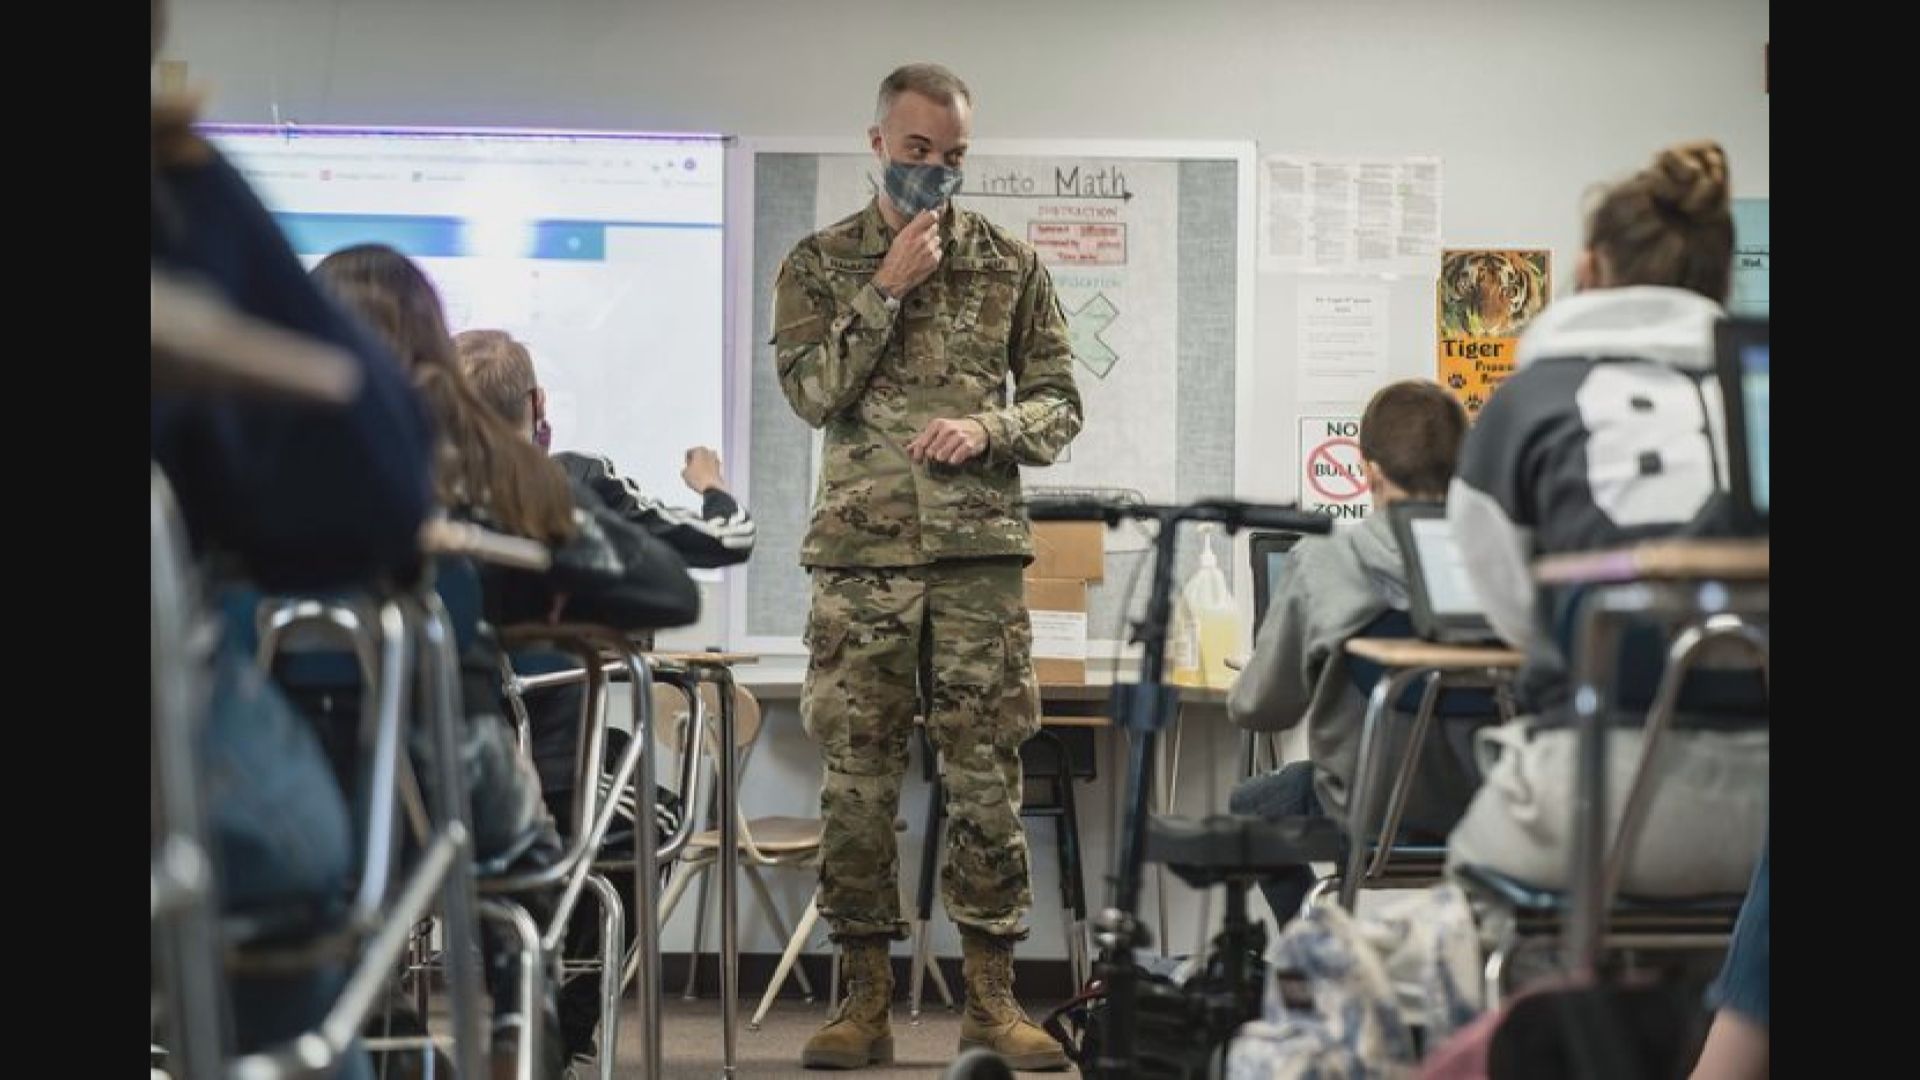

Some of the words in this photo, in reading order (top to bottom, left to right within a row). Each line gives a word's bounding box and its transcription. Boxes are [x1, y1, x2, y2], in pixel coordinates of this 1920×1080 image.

[981, 170, 1035, 194] into
[1055, 165, 1126, 198] Math
[1442, 339, 1504, 359] Tiger
[1327, 421, 1359, 437] NO
